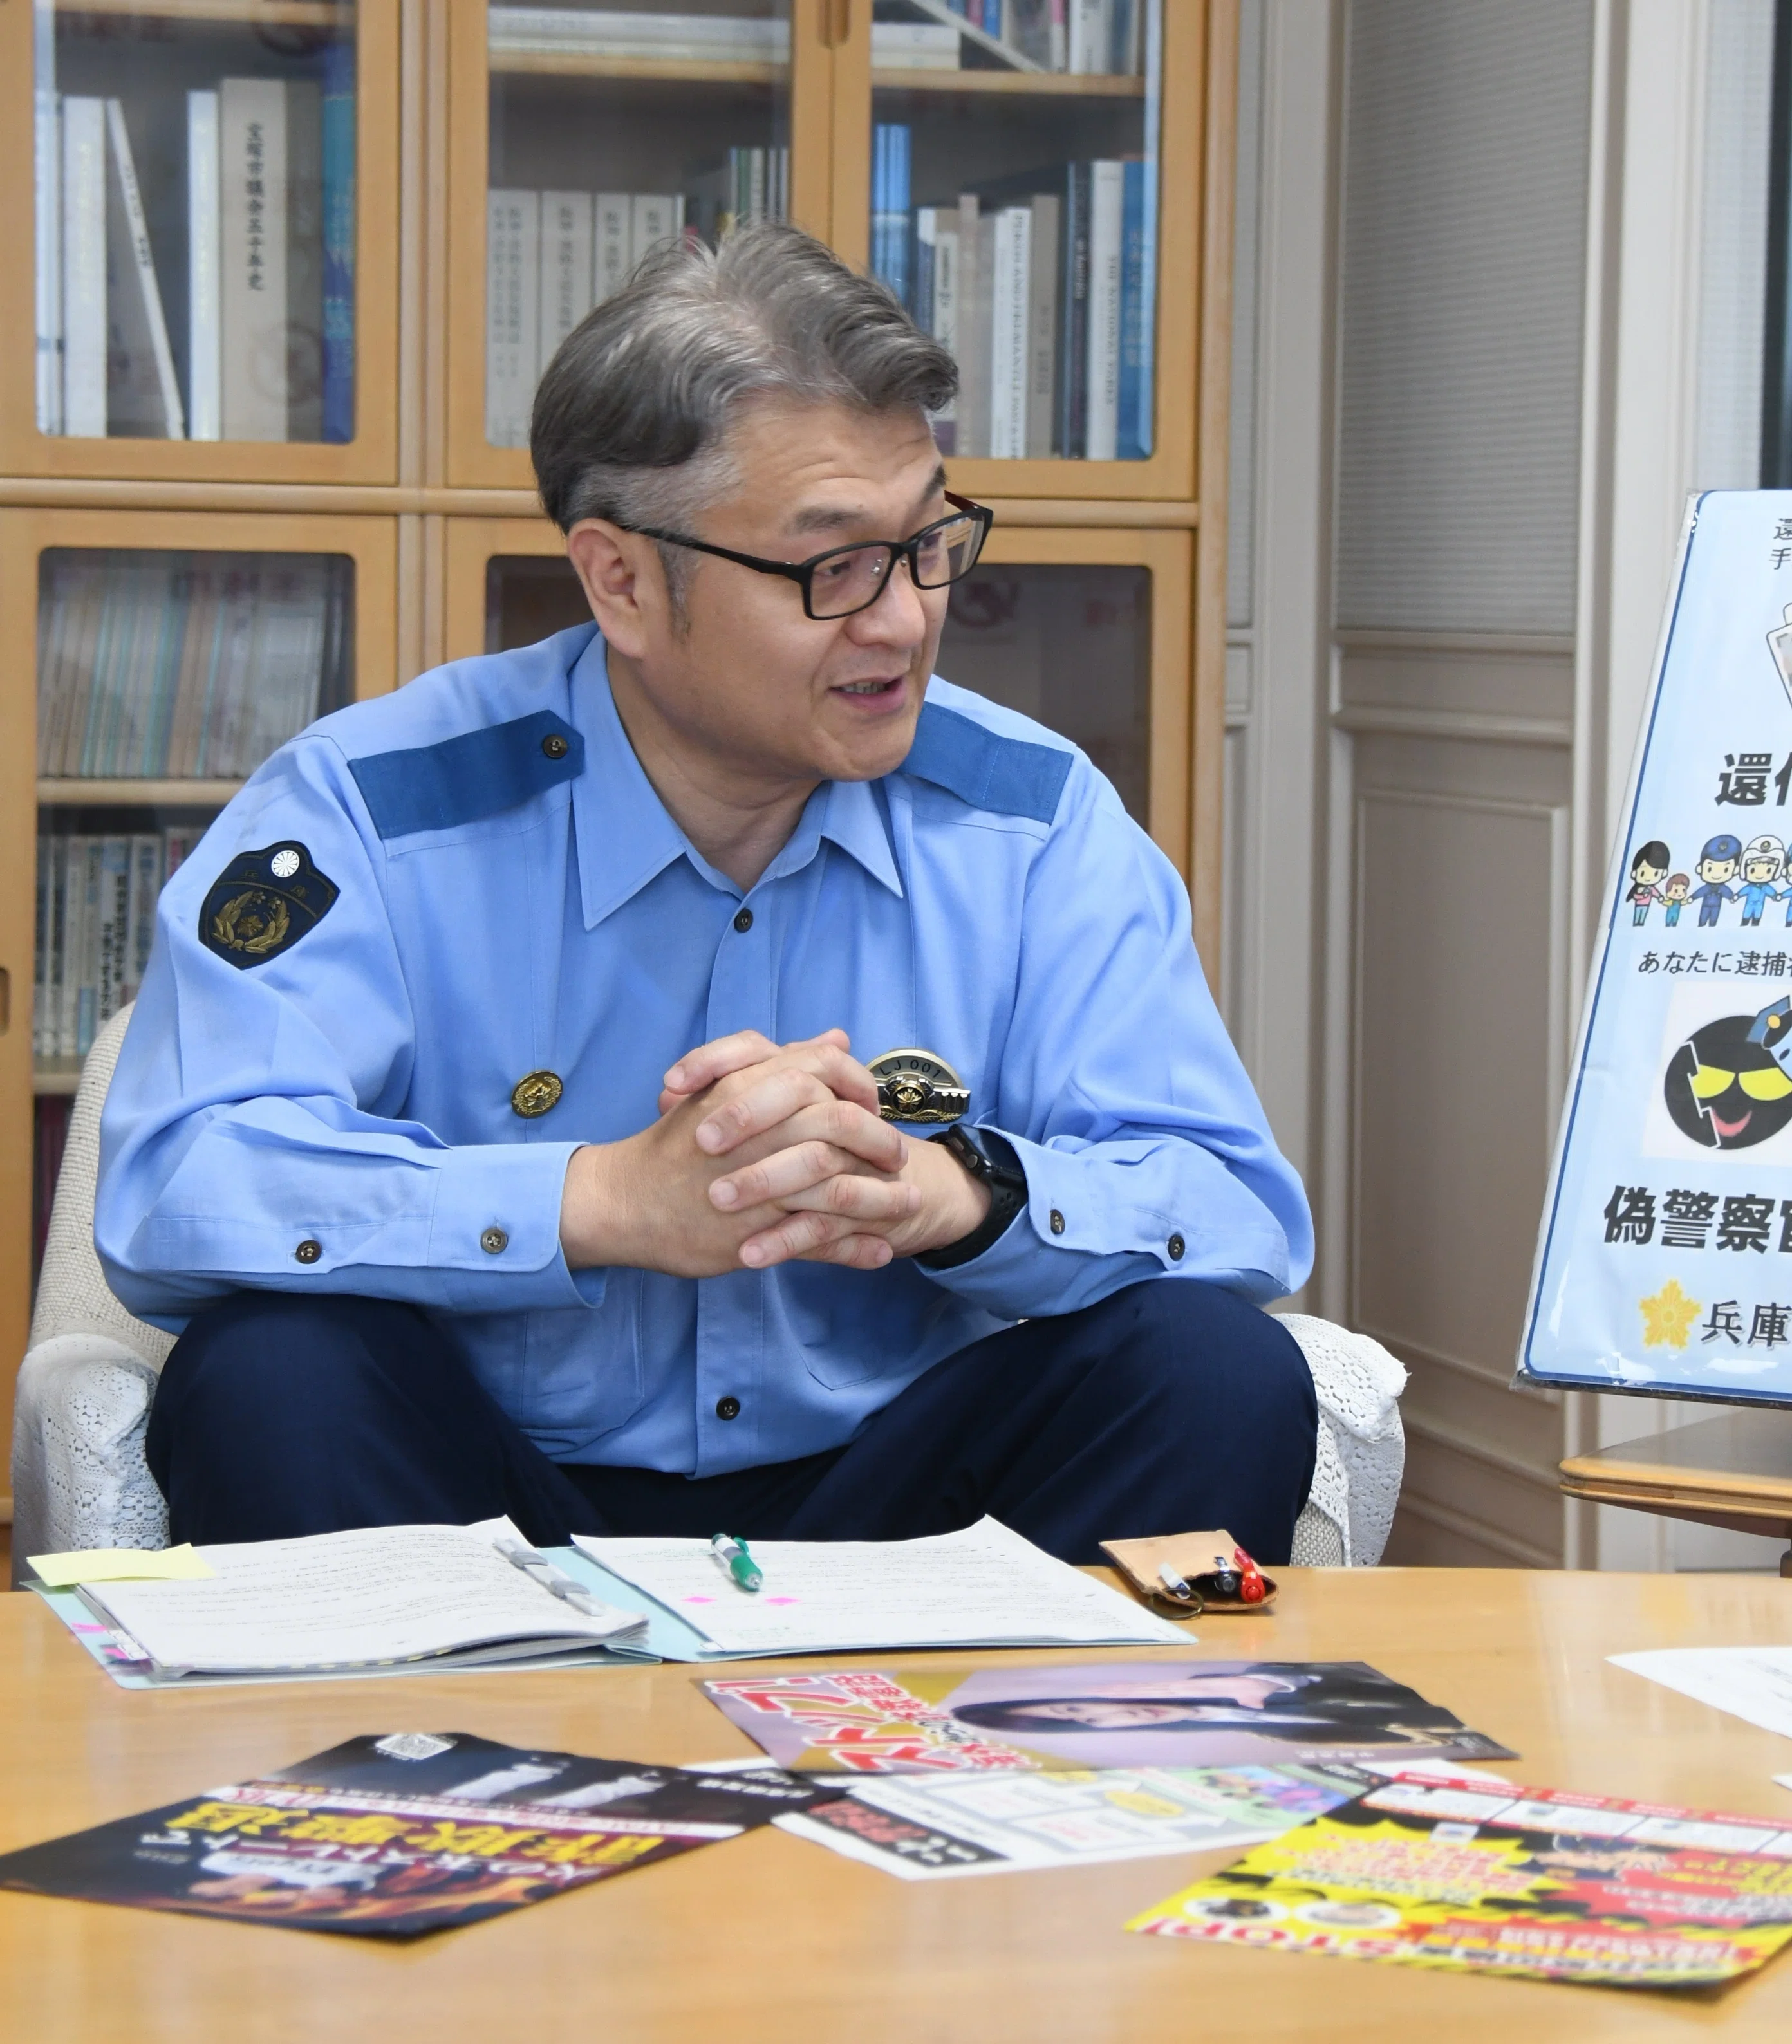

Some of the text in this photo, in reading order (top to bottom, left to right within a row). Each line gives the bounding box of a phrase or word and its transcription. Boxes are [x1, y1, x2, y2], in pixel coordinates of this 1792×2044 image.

[1638, 950, 1792, 978] あなたに逮捕
[910, 1059, 942, 1079] 001
[1603, 1185, 1792, 1254] 偽警察
[1701, 1299, 1792, 1351] 兵庫
